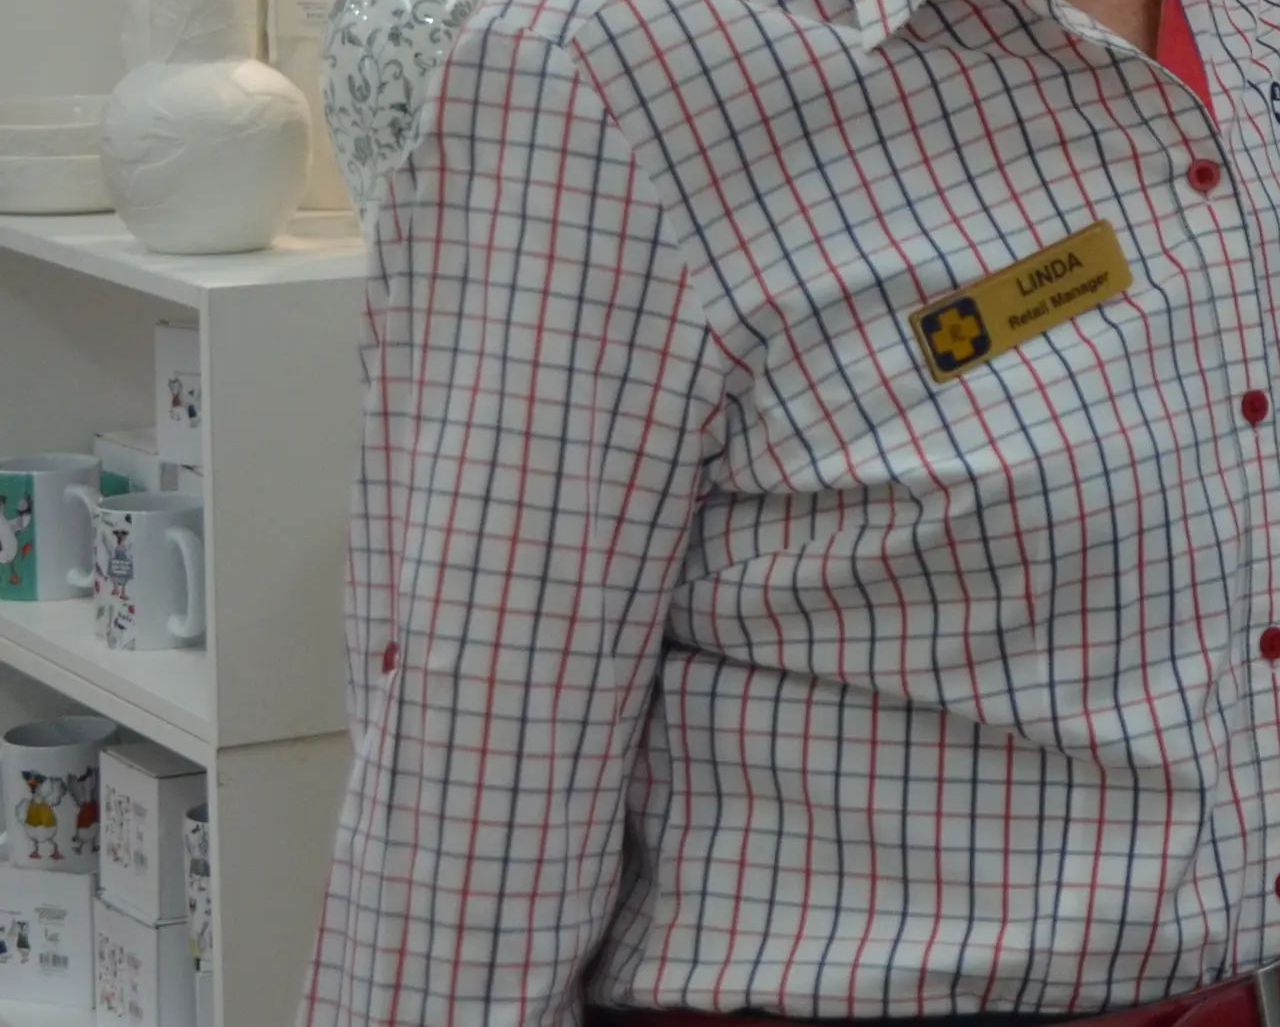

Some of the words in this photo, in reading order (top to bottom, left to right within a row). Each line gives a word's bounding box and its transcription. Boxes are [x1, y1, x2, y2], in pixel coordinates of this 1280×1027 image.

[1008, 301, 1049, 331] Retail
[1049, 270, 1109, 309] Manager
[1016, 252, 1083, 298] LINDA
